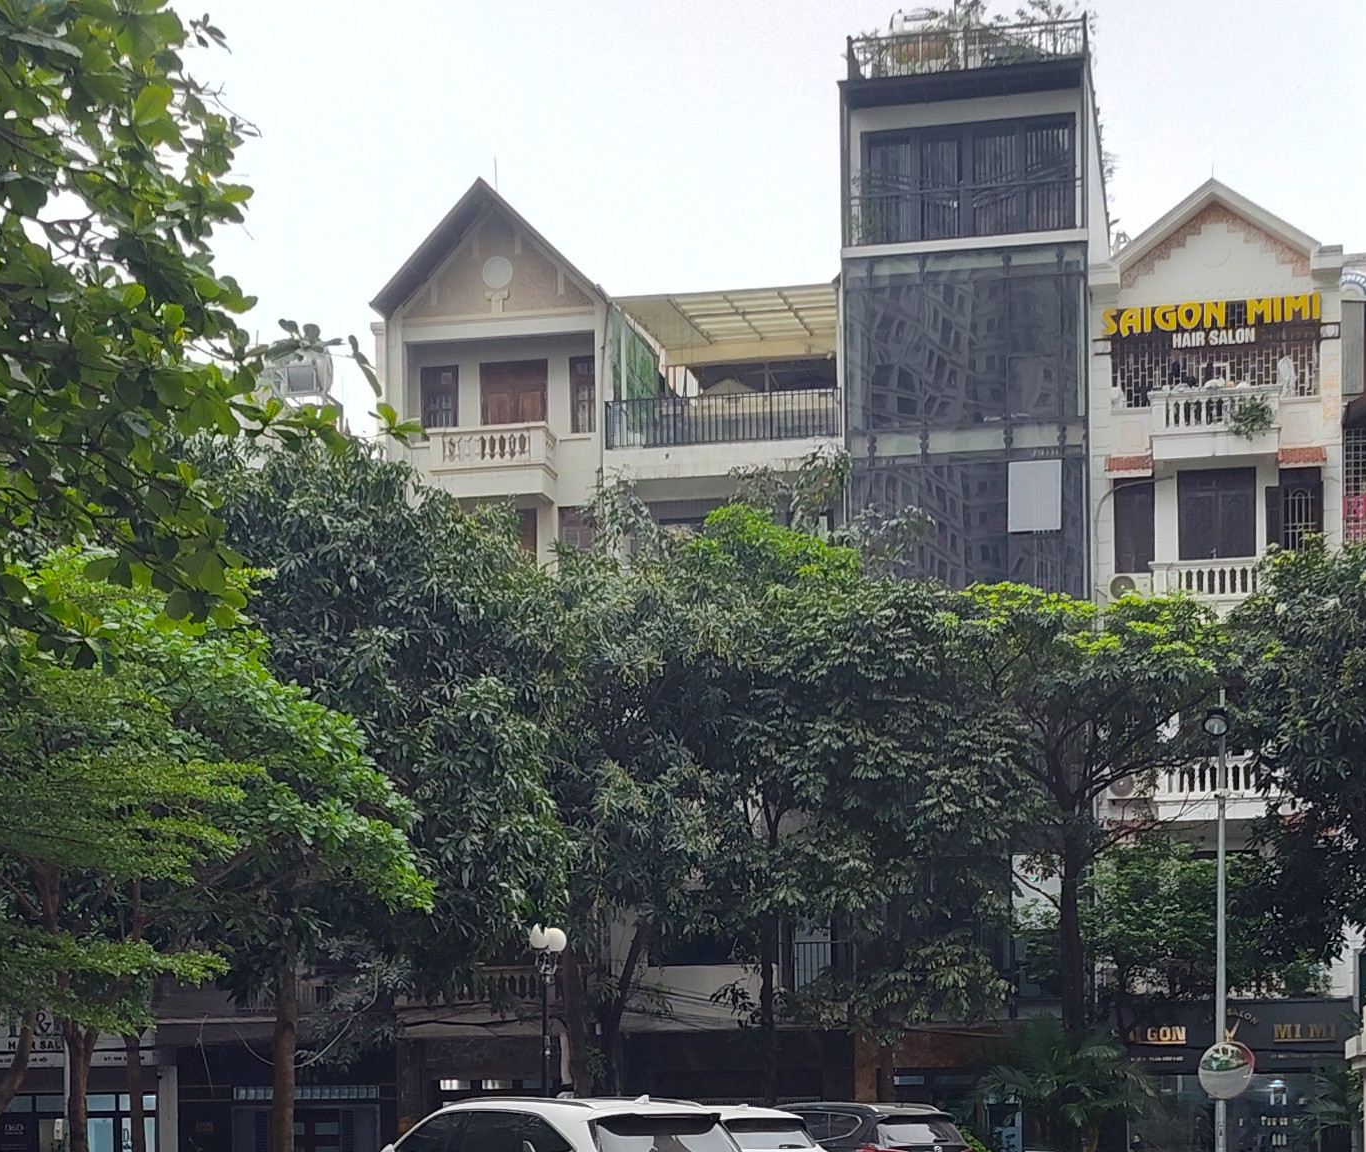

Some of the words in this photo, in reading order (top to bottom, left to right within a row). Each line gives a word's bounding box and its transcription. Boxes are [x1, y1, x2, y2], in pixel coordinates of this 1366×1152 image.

[1101, 299, 1226, 338] SAIGON
[1246, 292, 1321, 325] MIMI
[1172, 331, 1205, 349] HAIR
[1209, 327, 1255, 346] SALON
